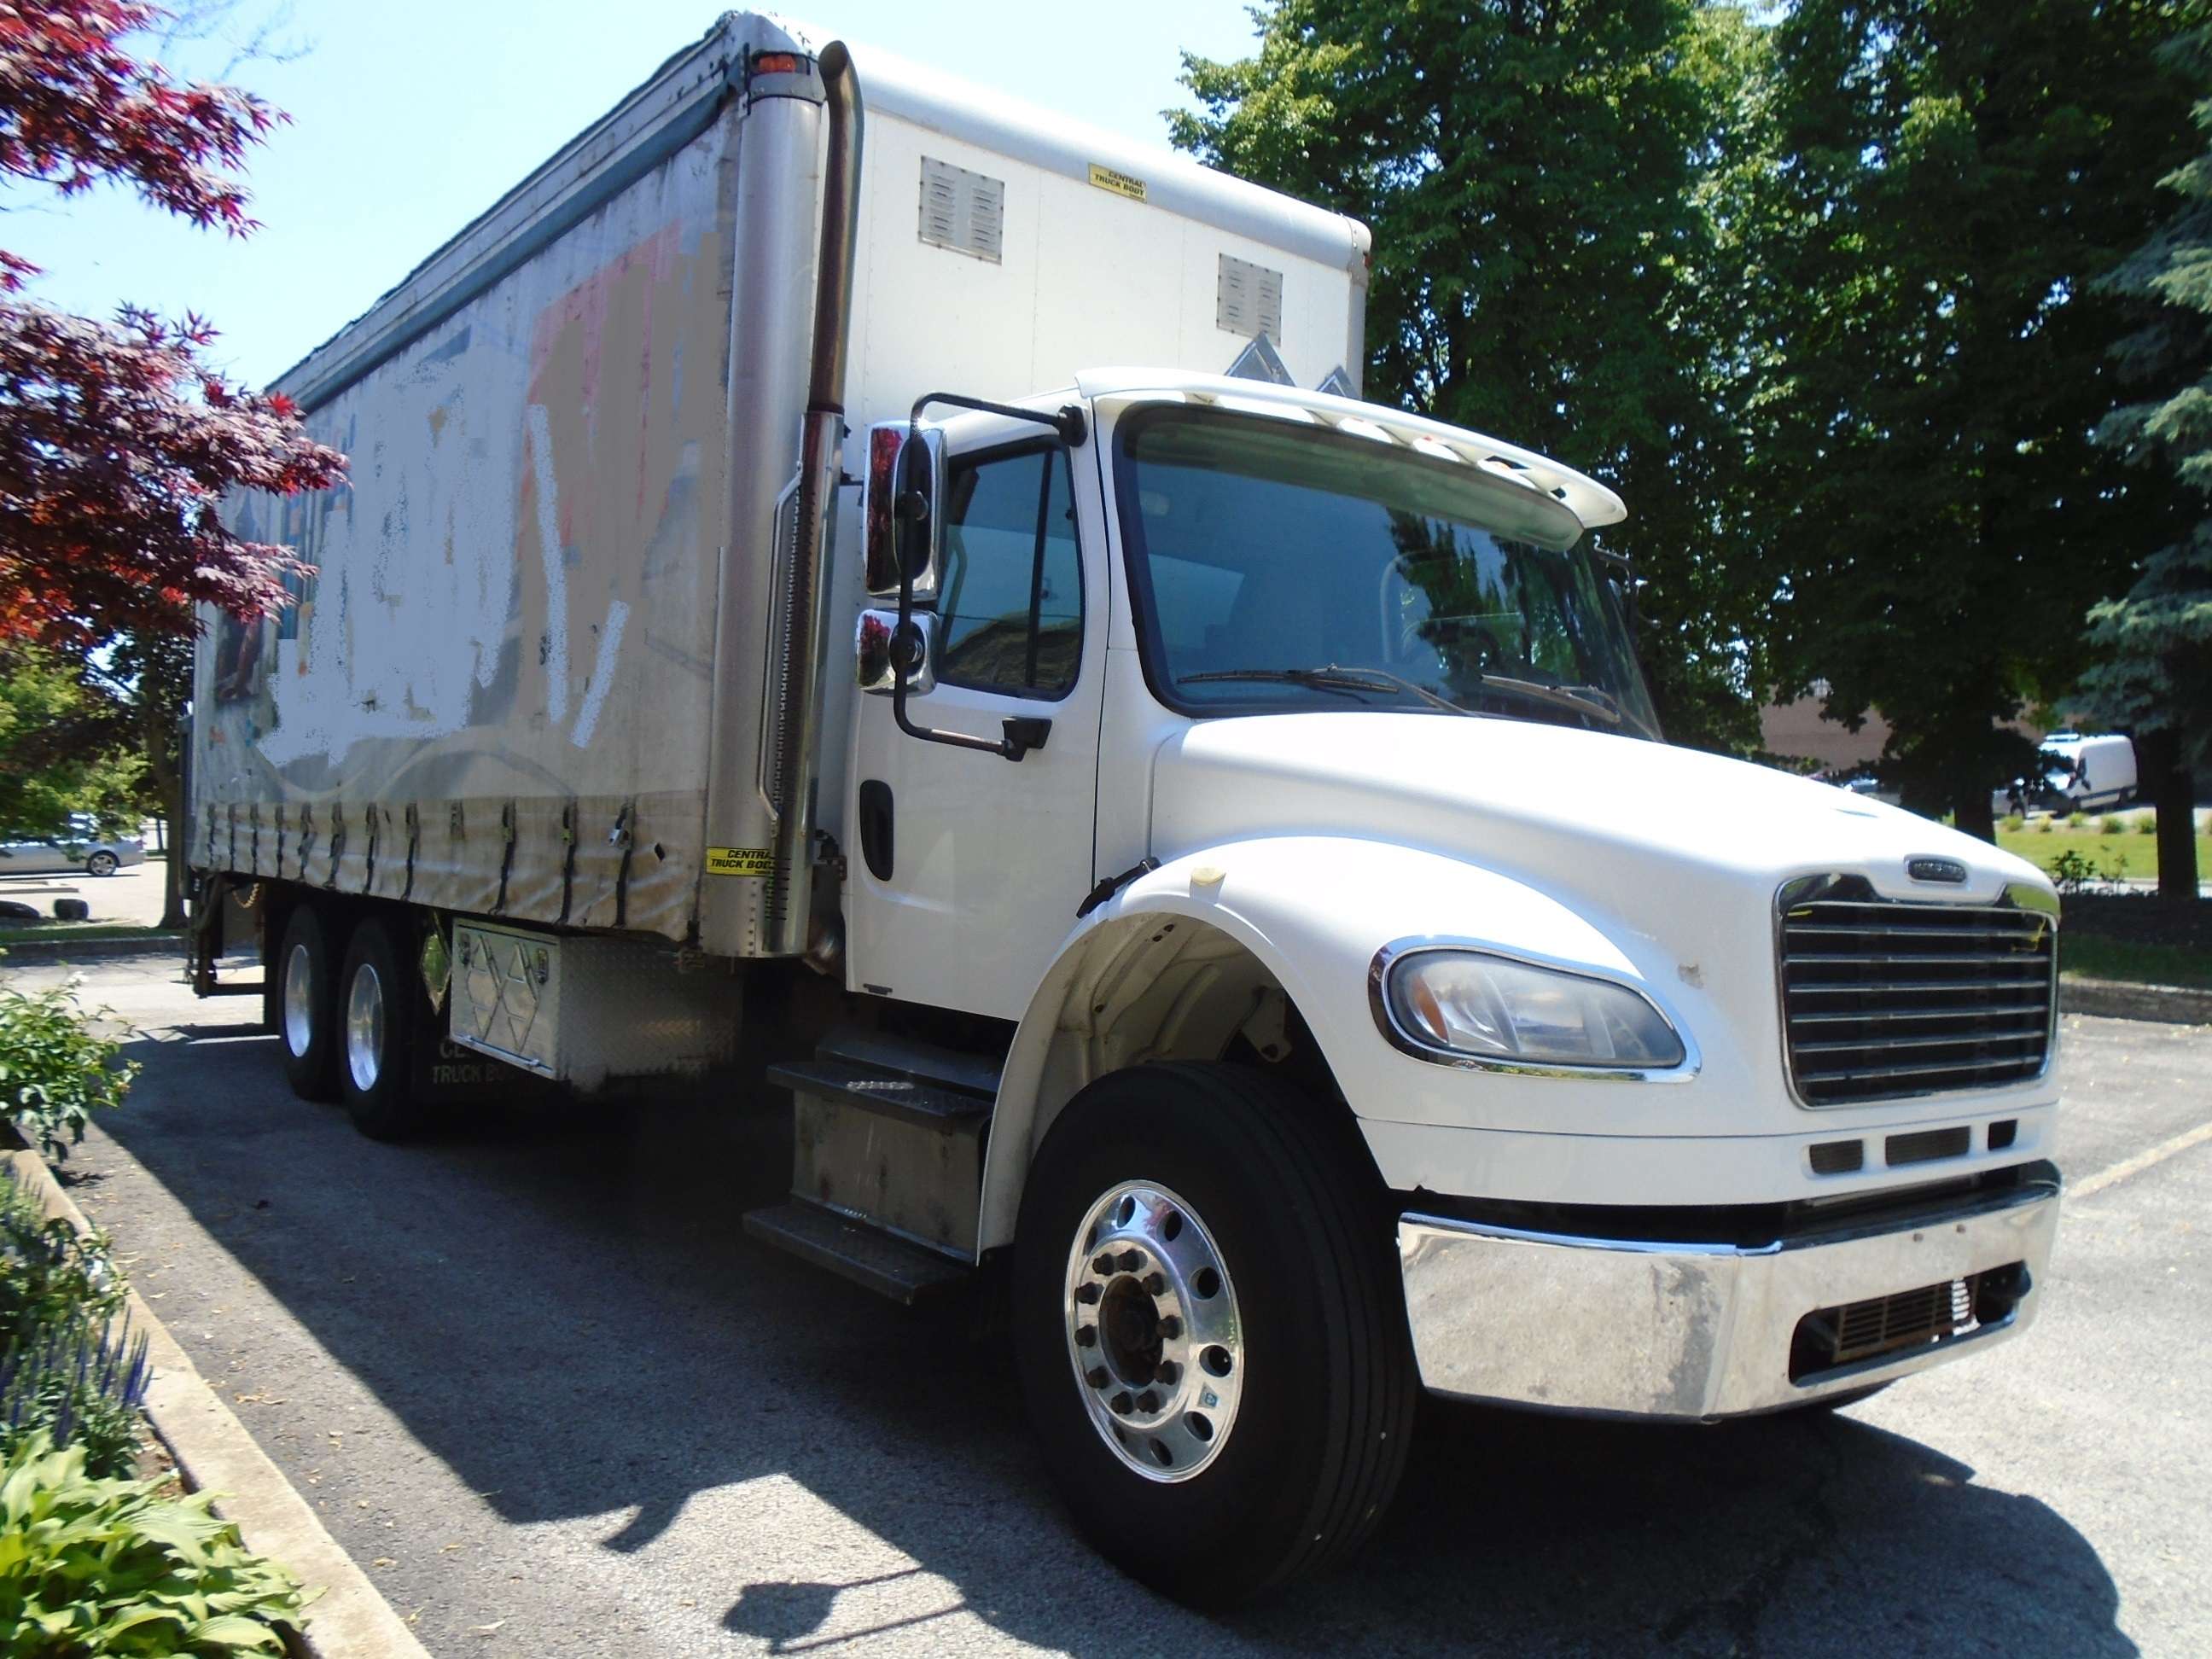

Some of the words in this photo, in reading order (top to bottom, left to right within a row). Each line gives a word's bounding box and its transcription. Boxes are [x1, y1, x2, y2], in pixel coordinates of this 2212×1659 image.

[1095, 173, 1121, 188] TRUCK
[1123, 183, 1144, 196] BODY
[1109, 171, 1144, 188] CENTRAL
[727, 849, 772, 859] CENTRA
[711, 859, 744, 869] TRUCK
[746, 859, 773, 870] BOD
[432, 1065, 479, 1084] TRUCK
